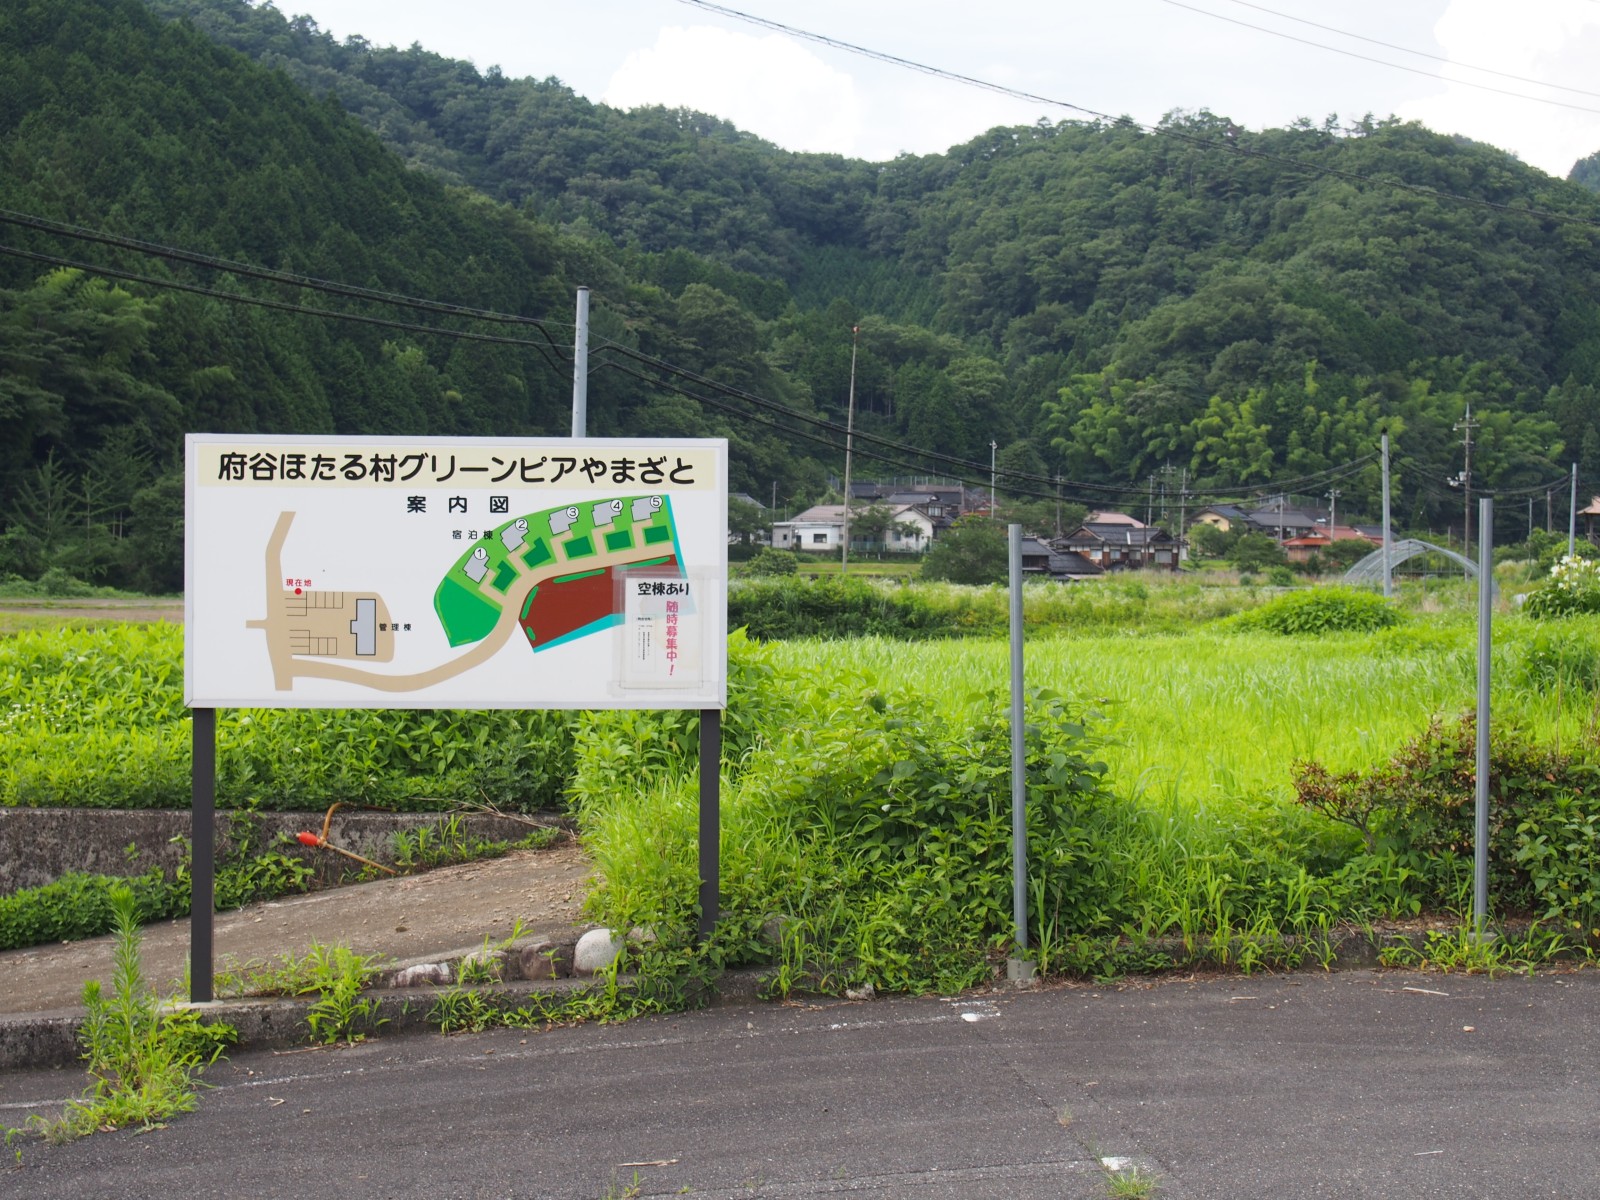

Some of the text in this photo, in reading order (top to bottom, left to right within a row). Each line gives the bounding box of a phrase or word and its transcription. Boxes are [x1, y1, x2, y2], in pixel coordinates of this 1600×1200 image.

[217, 452, 695, 485] 府谷ほたる村グリーンピアやまざと
[407, 495, 508, 514] 案内図
[451, 529, 493, 541] 宿泊棟
[286, 578, 313, 587] 現在地
[637, 581, 690, 597] 空棟あり
[379, 622, 412, 632] 管理棟
